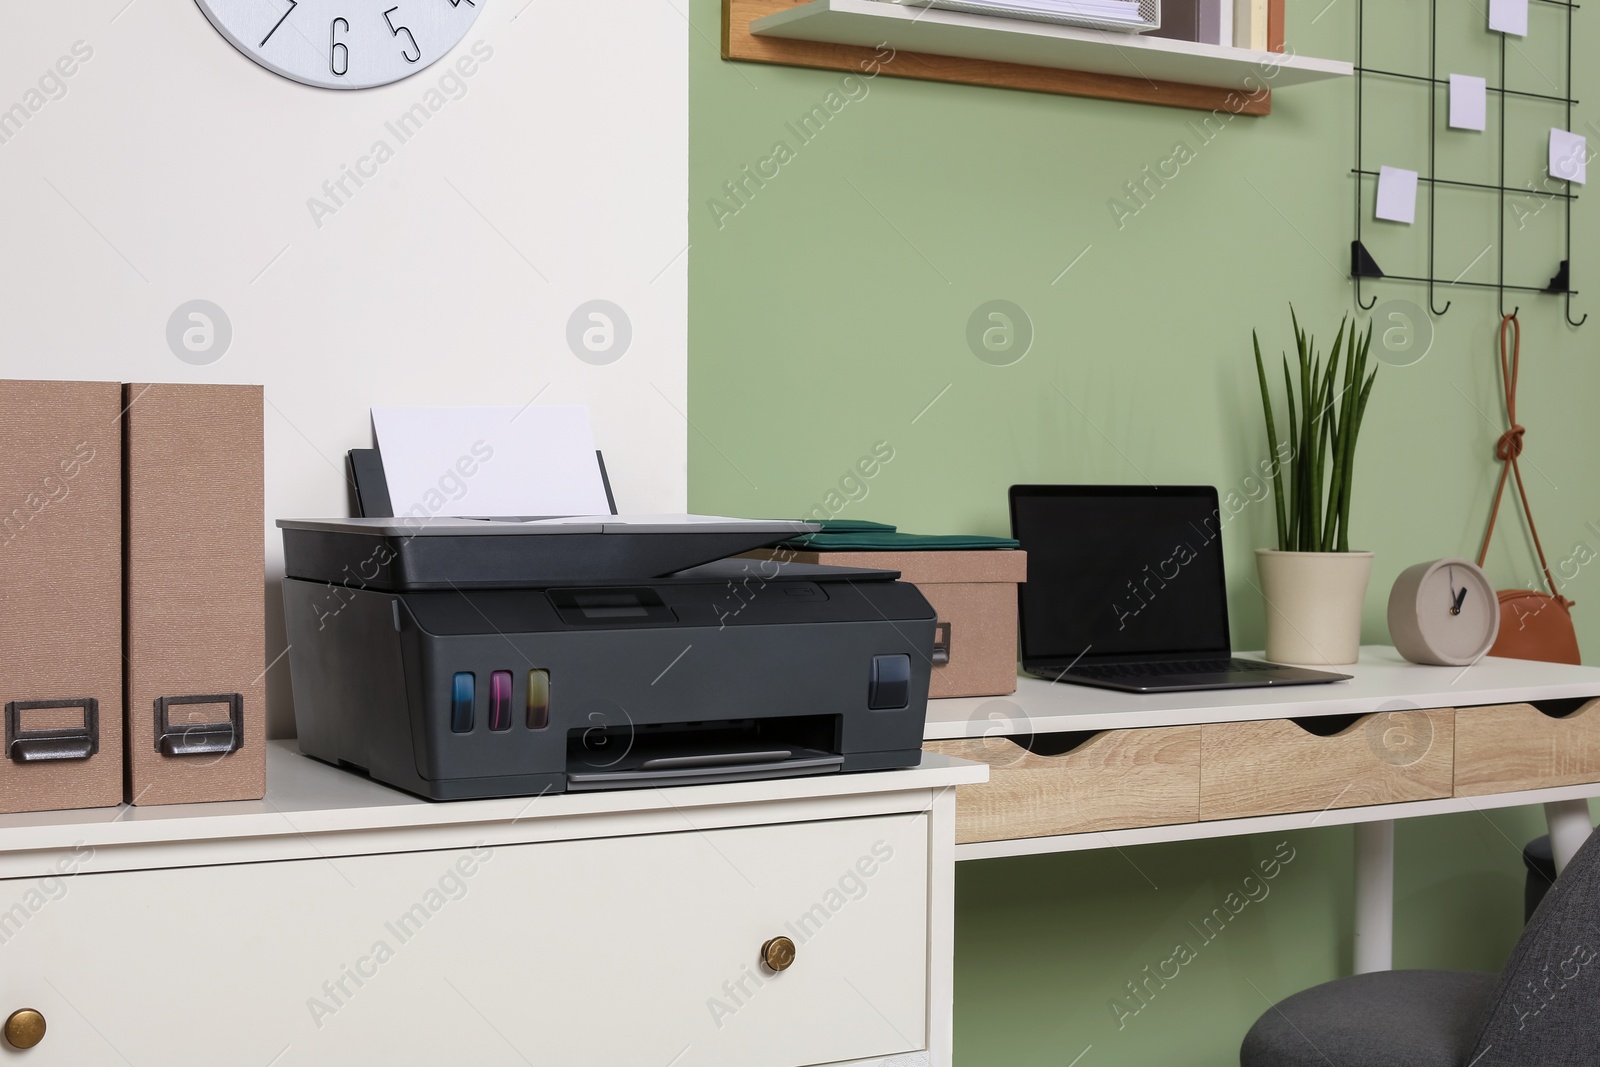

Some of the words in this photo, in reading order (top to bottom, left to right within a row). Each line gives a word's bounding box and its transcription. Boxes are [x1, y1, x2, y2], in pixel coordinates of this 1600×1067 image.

[258, 0, 298, 48] 7
[329, 16, 350, 77] 6
[382, 5, 421, 63] 5
